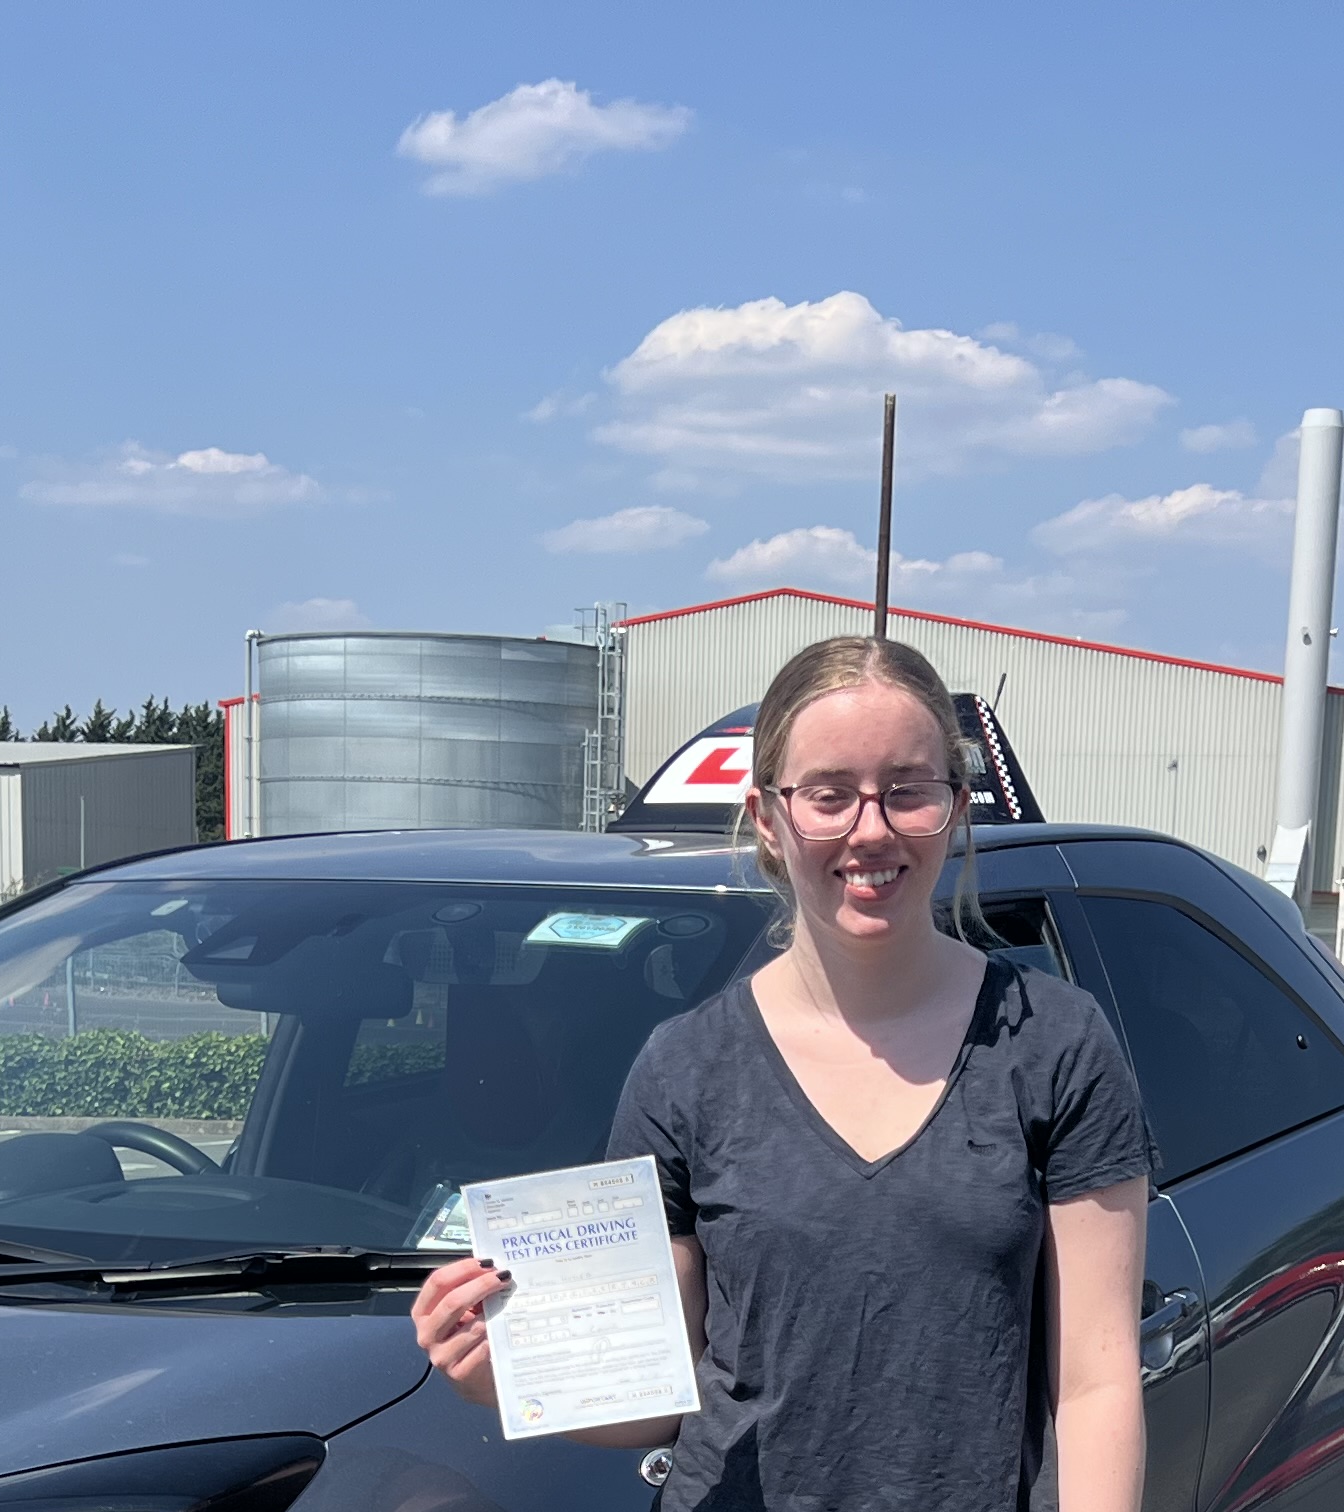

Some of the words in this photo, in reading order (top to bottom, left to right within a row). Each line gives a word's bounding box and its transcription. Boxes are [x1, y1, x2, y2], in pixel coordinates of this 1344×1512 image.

[684, 747, 749, 785] L
[502, 1227, 573, 1249] PRACTICAL
[577, 1217, 636, 1235] DRIVING
[504, 1247, 531, 1261] TEST
[535, 1242, 562, 1257] PASS
[565, 1230, 639, 1251] CERTIFICATE
